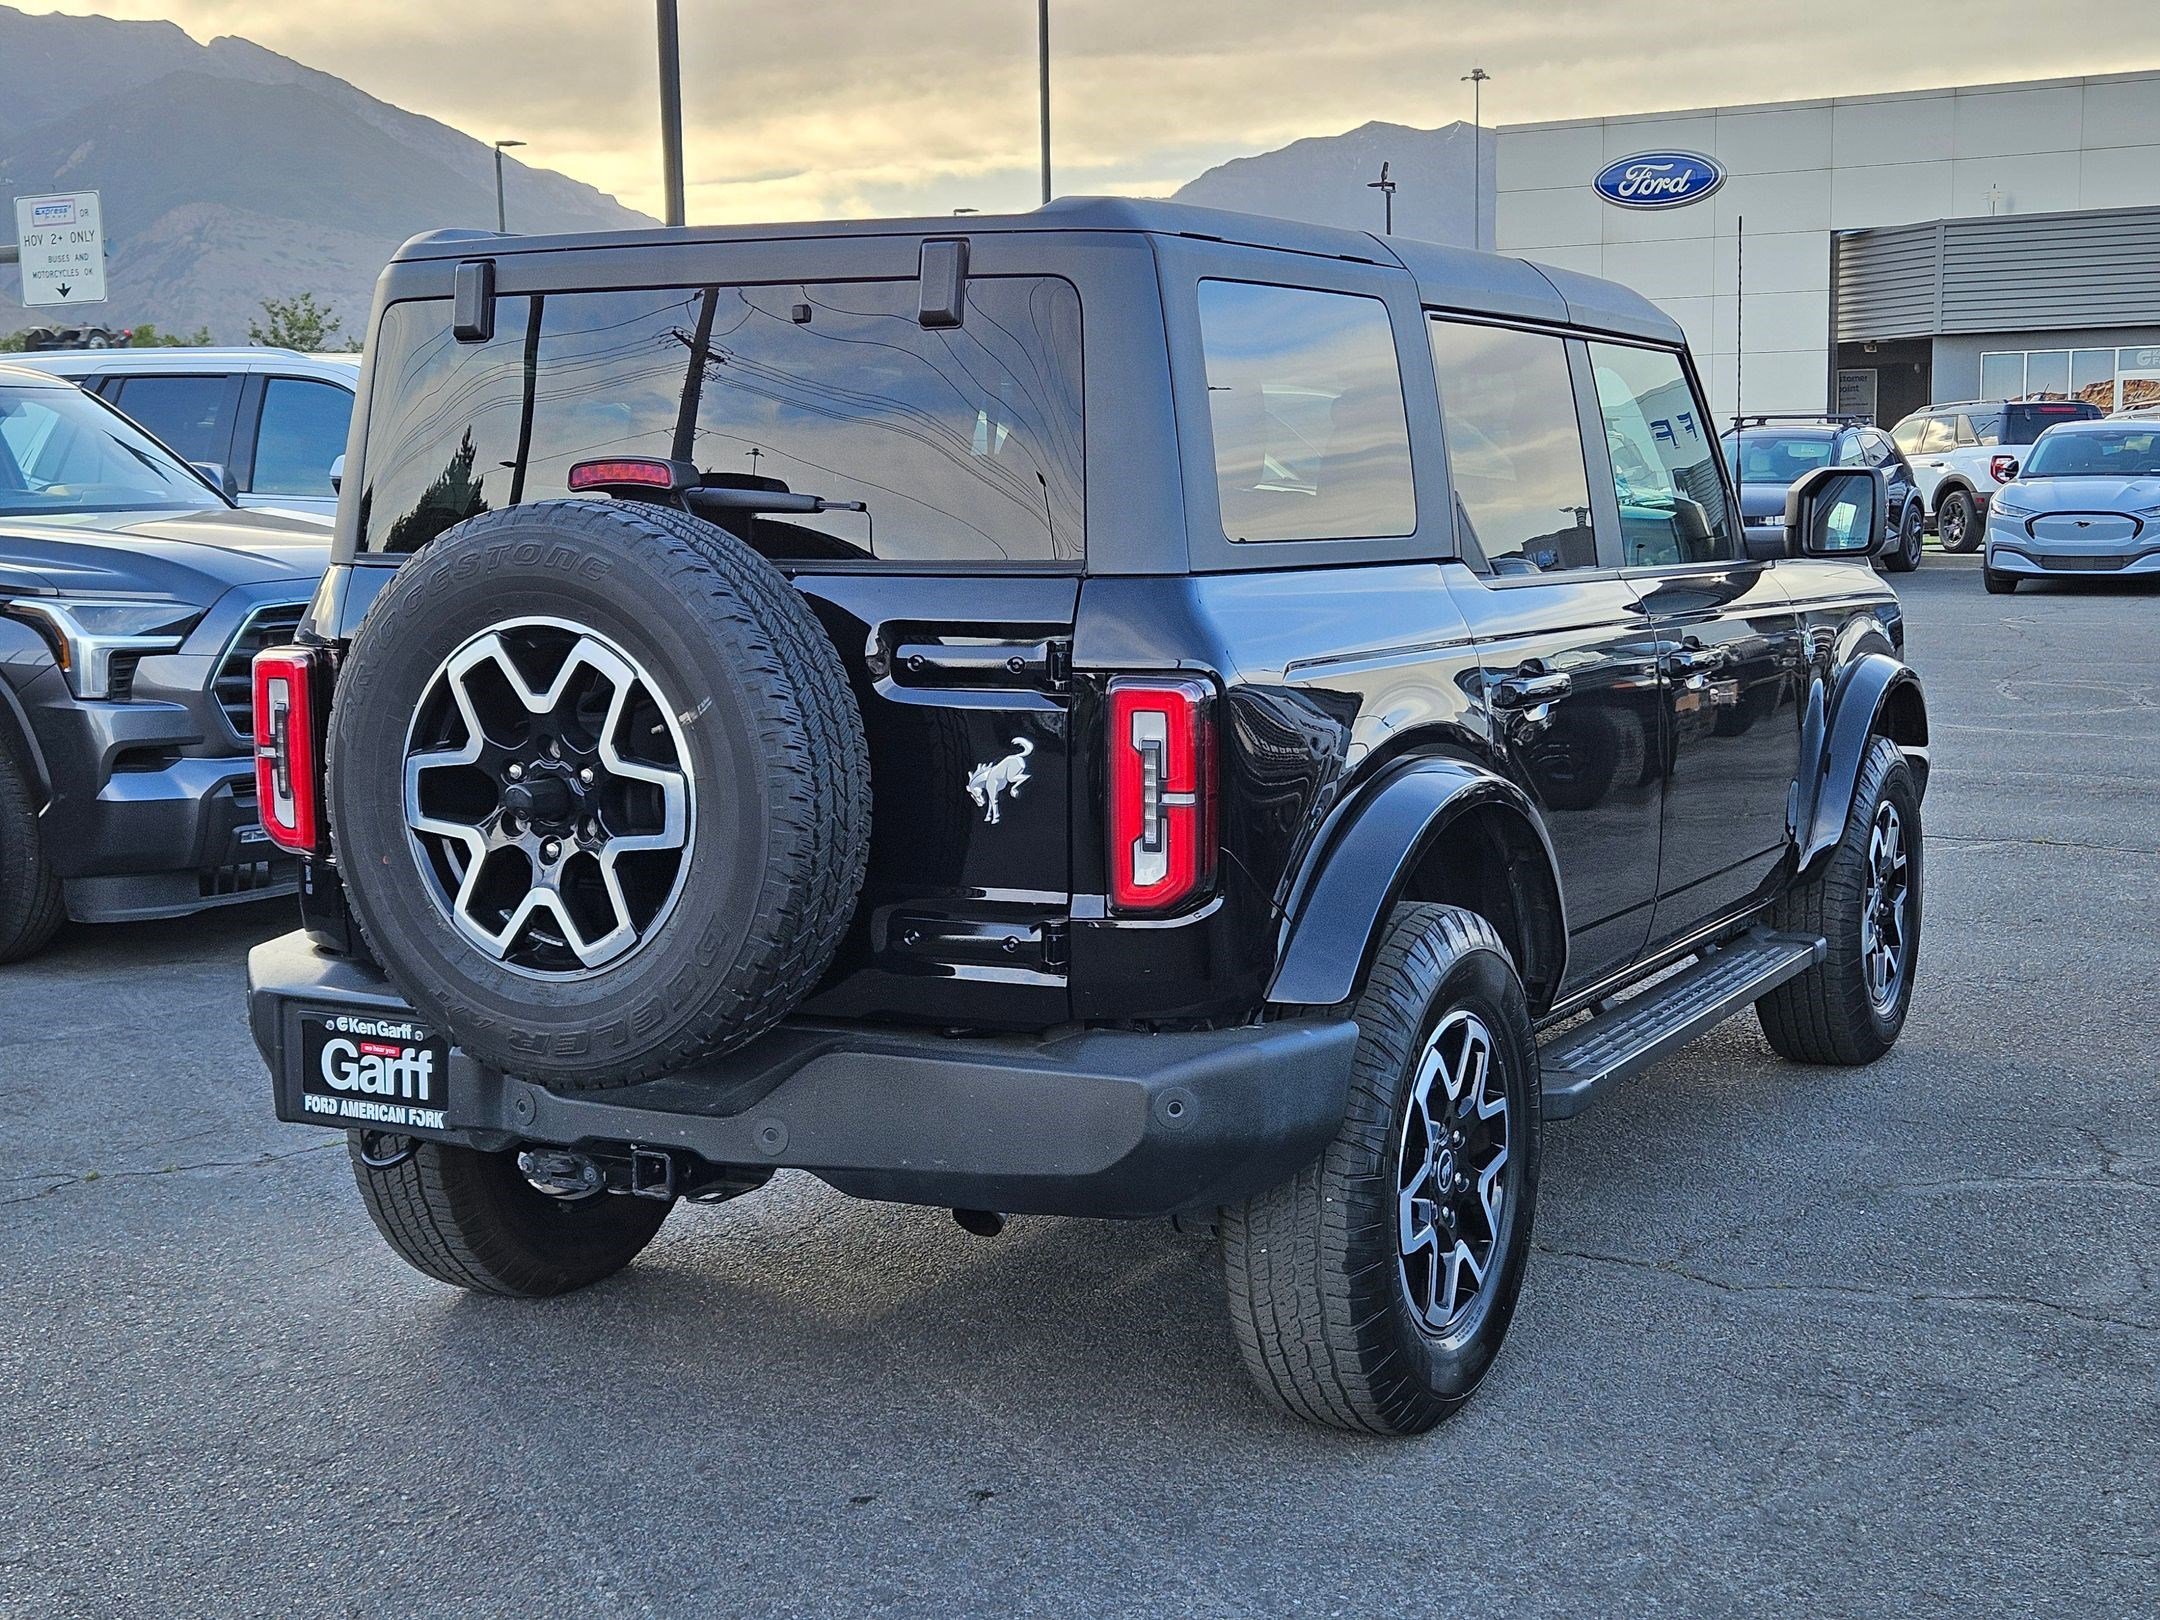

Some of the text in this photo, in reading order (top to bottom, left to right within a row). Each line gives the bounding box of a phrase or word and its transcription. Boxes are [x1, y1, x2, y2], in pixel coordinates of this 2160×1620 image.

[1618, 163, 1693, 197] Ford
[35, 204, 89, 217] Express OR
[24, 230, 95, 247] HOV 2+ ONLY
[48, 253, 89, 263] BUSES AND
[32, 268, 94, 279] MOTORCYCLES OK
[385, 1047, 396, 1055] you
[321, 1038, 433, 1101] Garff
[304, 1095, 445, 1130] FORD AMERICAN FORK
